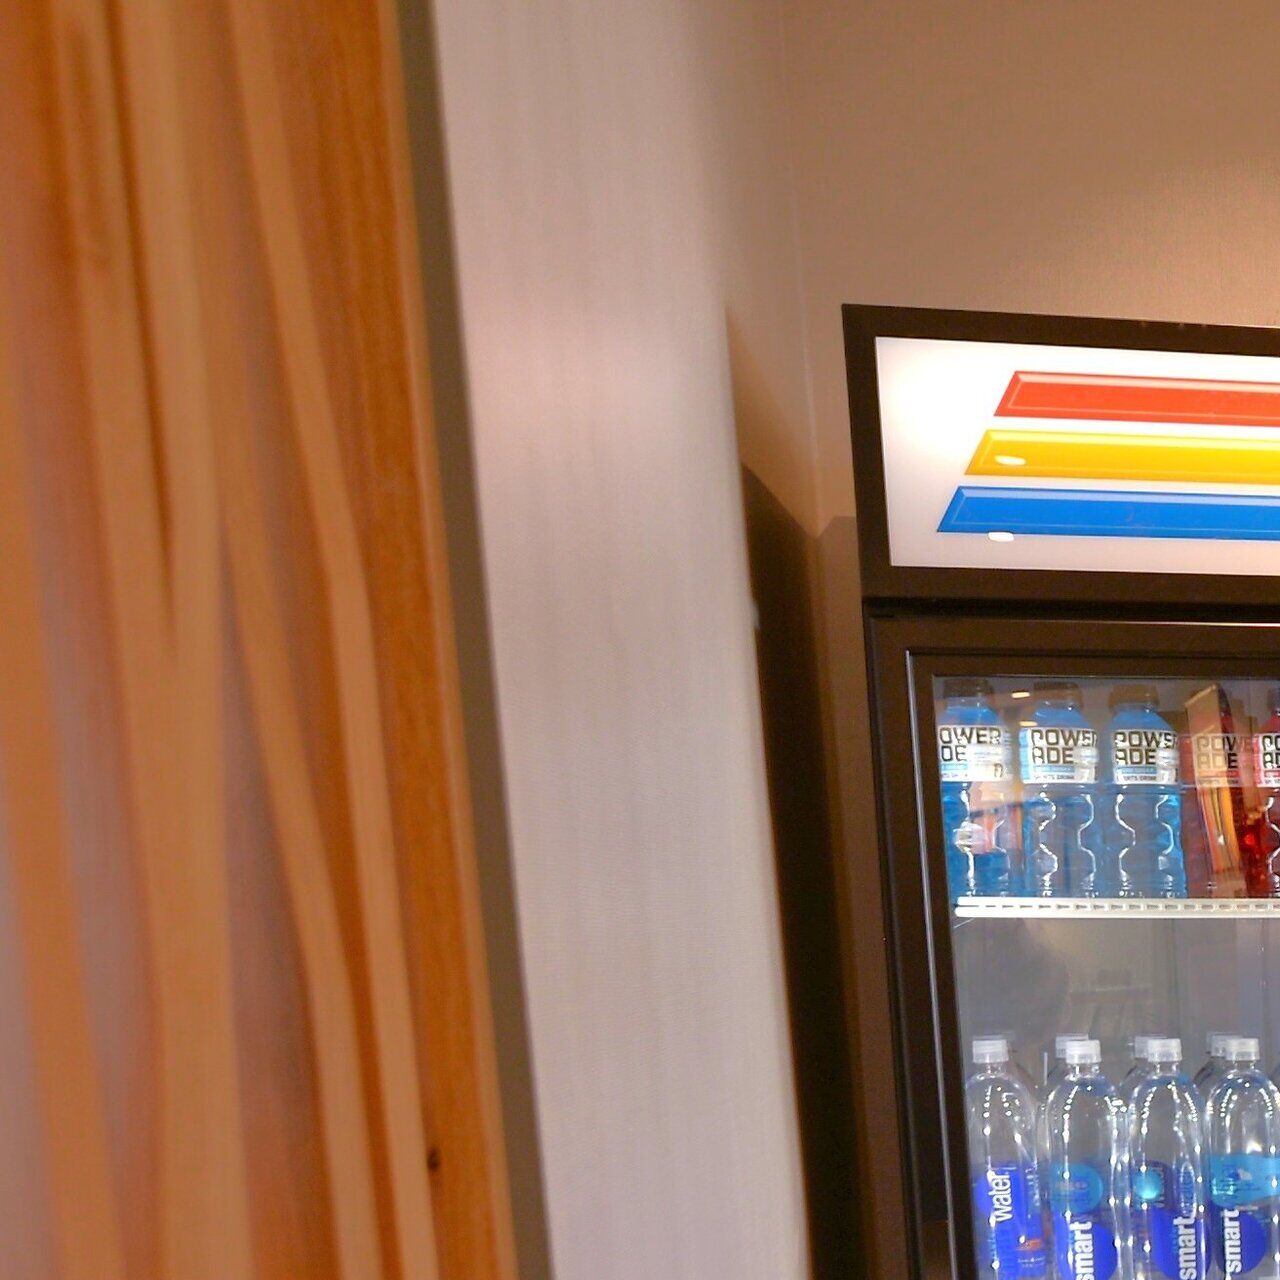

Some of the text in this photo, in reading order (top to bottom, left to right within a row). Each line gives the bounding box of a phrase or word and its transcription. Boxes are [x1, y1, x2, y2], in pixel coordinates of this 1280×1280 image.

[939, 727, 1001, 745] OWER
[941, 745, 967, 761] DE
[1032, 747, 1073, 764] ADE
[1115, 748, 1156, 765] ADE
[988, 1171, 1013, 1222] water
[1223, 1209, 1243, 1274] smart
